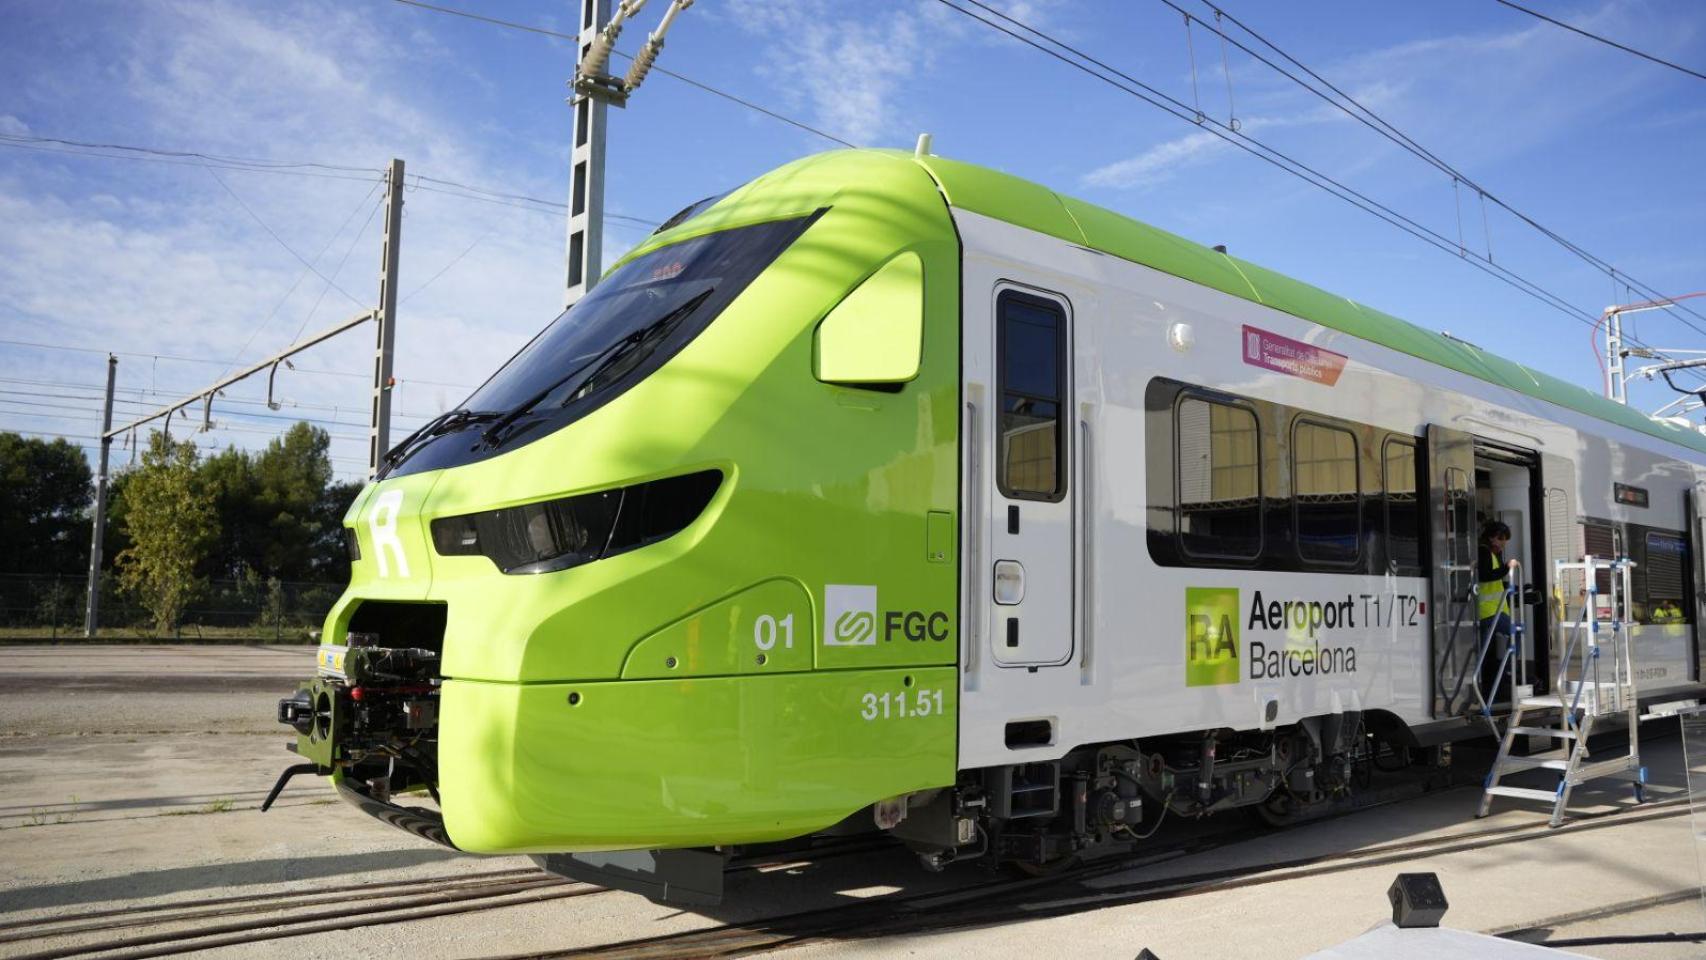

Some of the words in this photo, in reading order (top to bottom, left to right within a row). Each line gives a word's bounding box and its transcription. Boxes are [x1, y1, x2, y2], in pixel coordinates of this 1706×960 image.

[1262, 339, 1296, 358] Generalitat
[368, 489, 411, 578] R
[754, 613, 794, 651] 01
[884, 611, 949, 642] FGC
[1248, 590, 1355, 637] Aeroport
[1190, 614, 1237, 661] RA
[1250, 639, 1357, 680] Barcelona
[861, 688, 943, 721] 311.51
